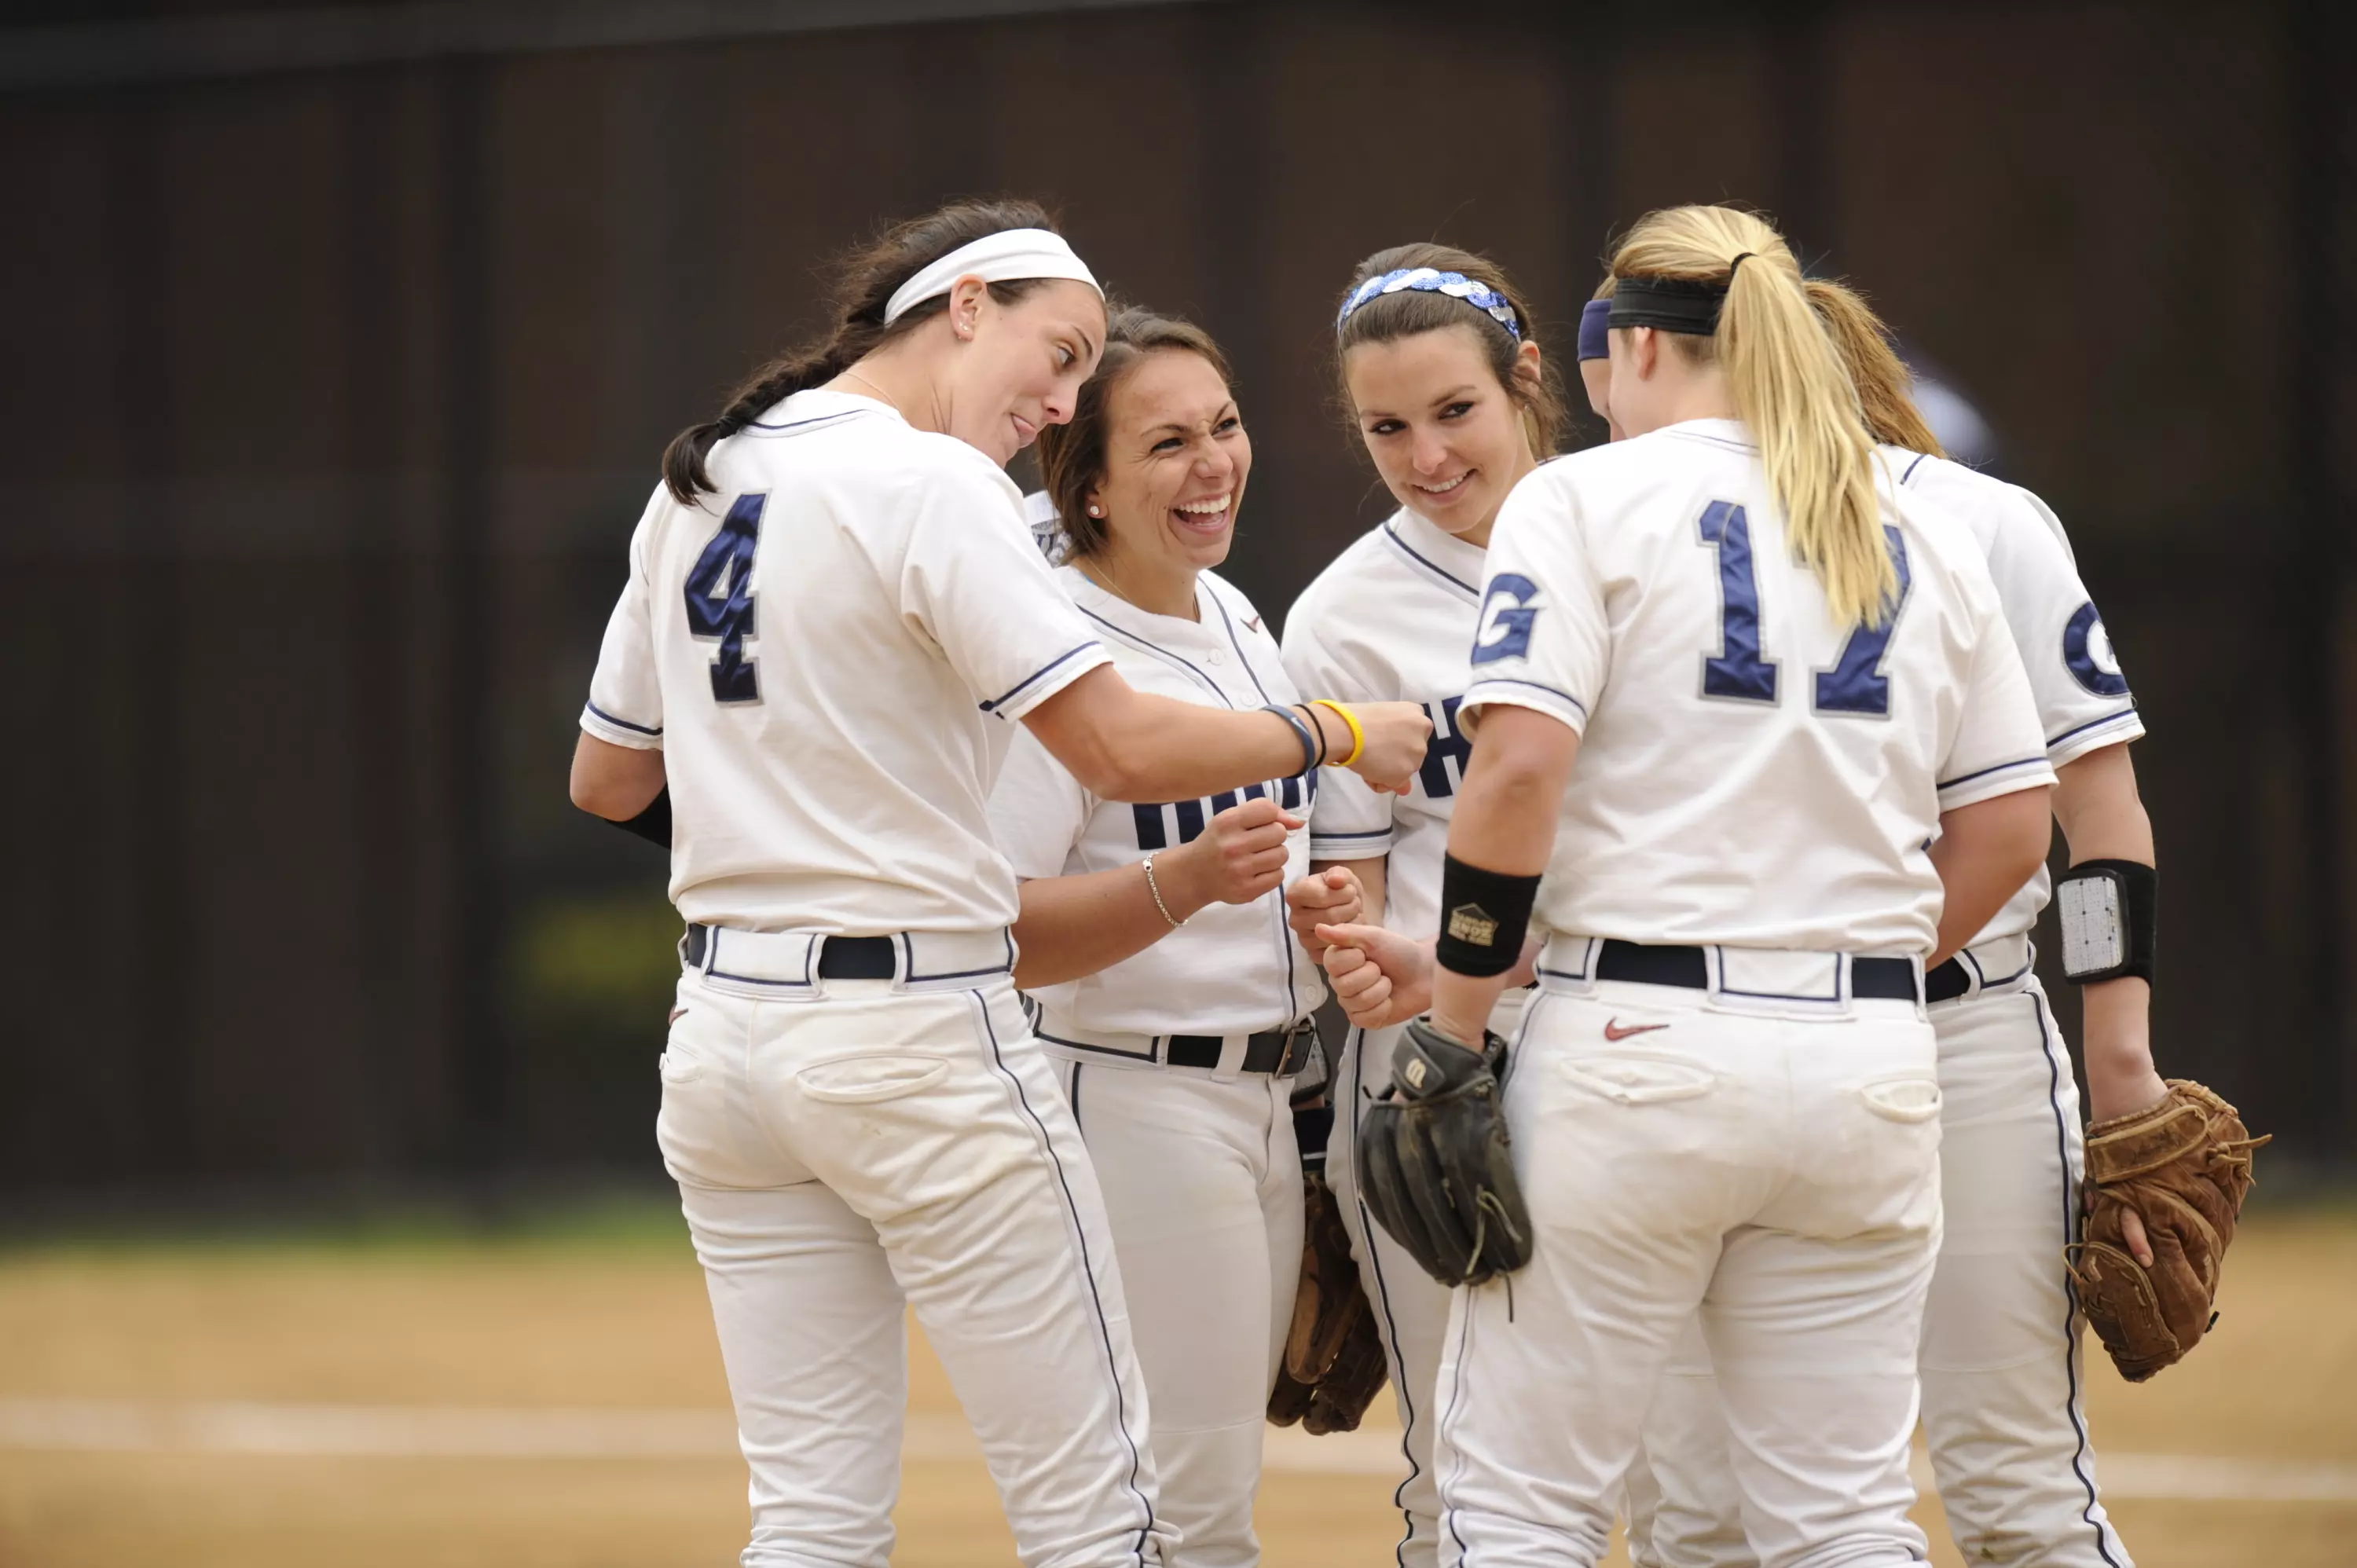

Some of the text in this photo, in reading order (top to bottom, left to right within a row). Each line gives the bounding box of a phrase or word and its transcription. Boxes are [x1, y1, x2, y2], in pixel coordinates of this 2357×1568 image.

[683, 489, 770, 705] 4
[1469, 572, 1540, 668] G
[1692, 498, 1915, 721] 17
